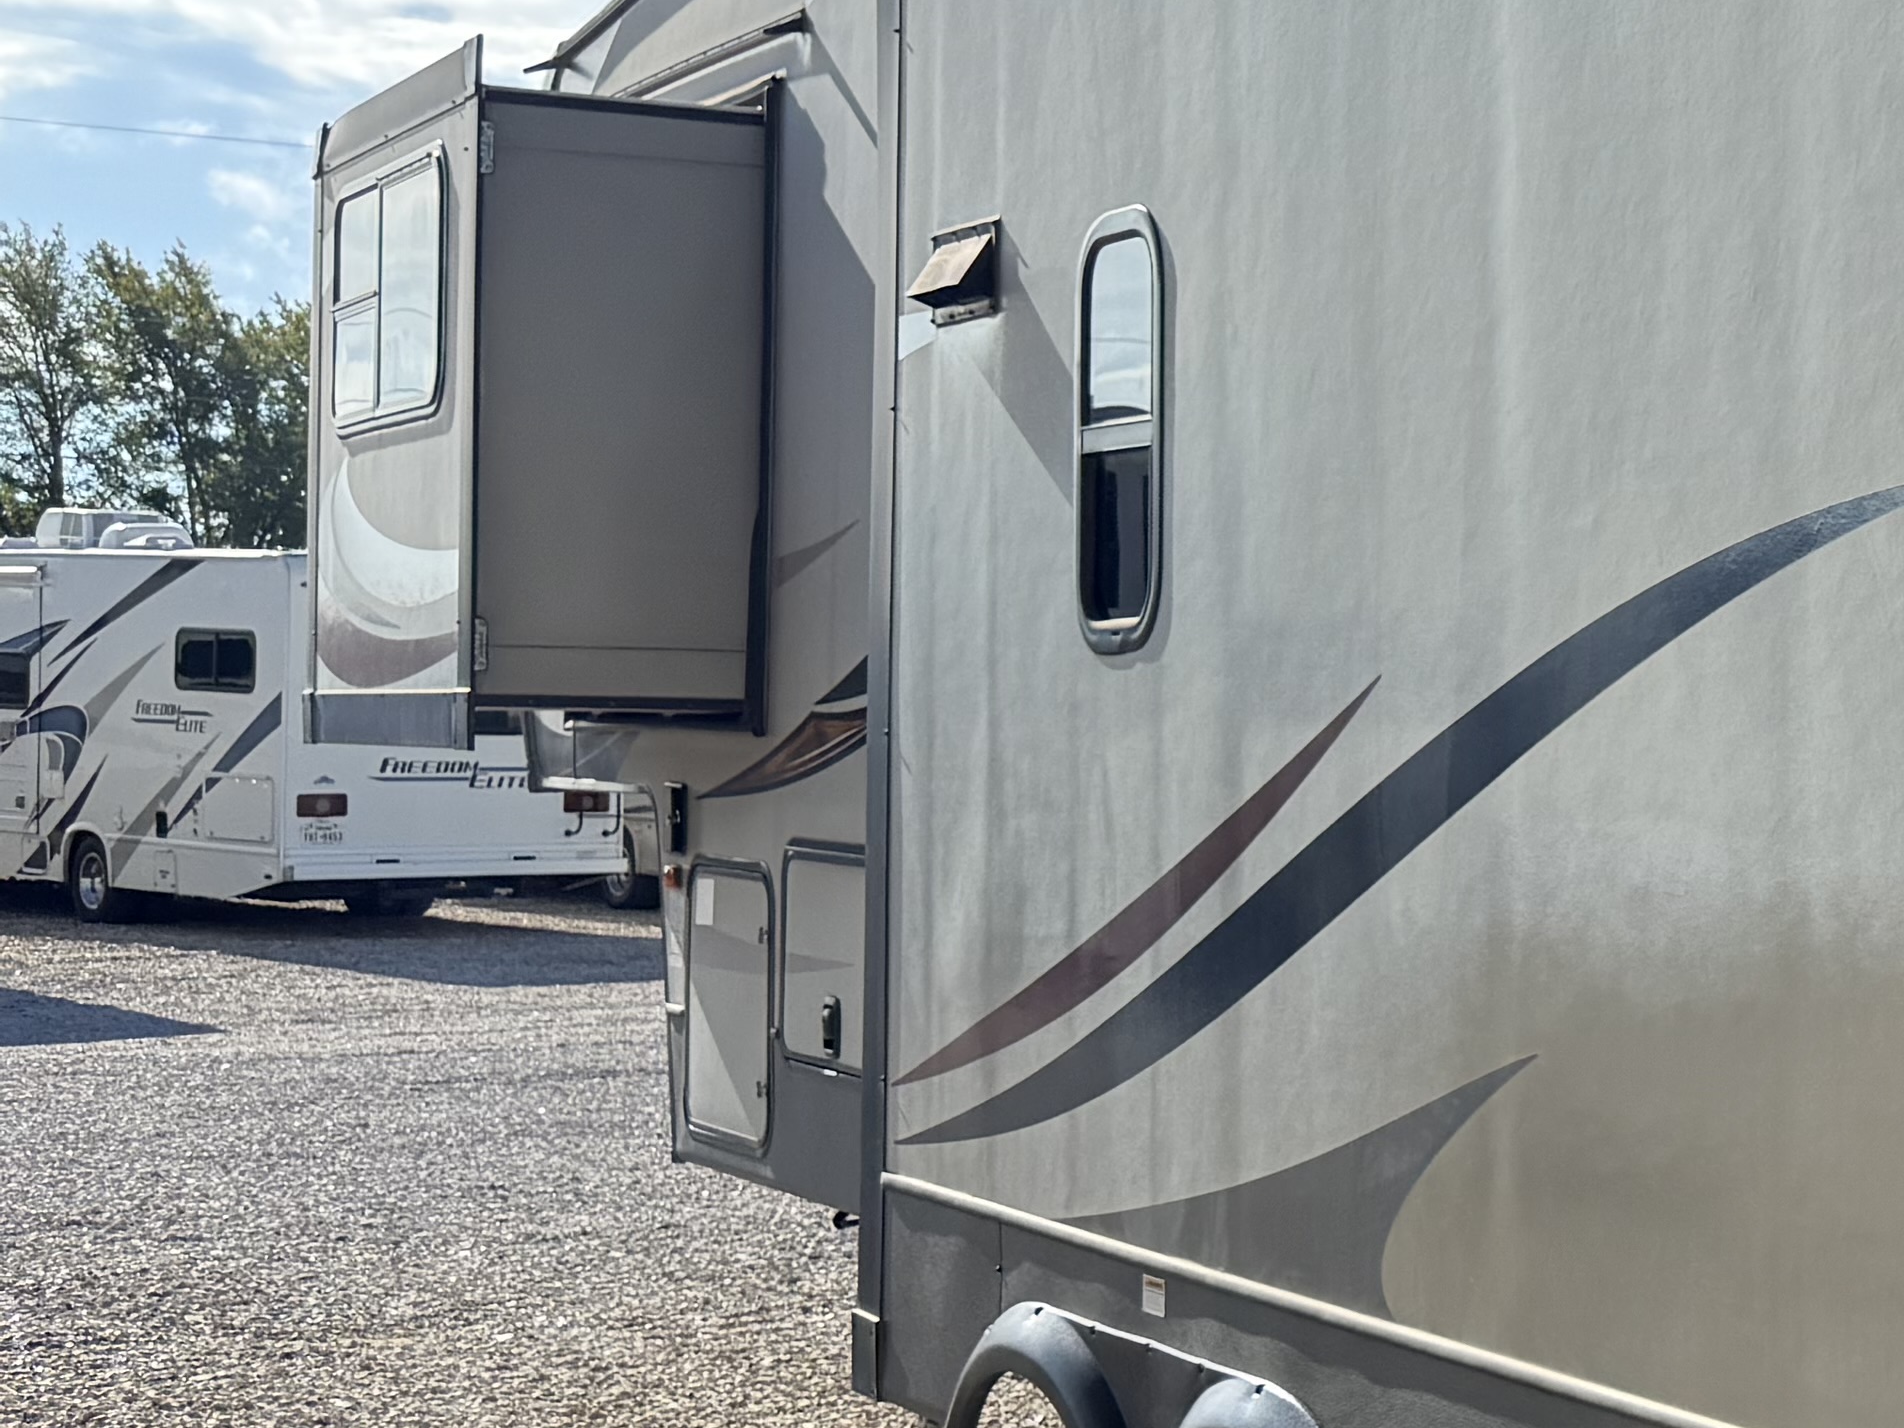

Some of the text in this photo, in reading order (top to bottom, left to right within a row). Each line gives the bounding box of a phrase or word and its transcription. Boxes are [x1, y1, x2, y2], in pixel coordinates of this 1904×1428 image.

[135, 698, 181, 717] FREEDOM
[175, 714, 207, 733] ELITE
[379, 756, 479, 774] FREEDOM
